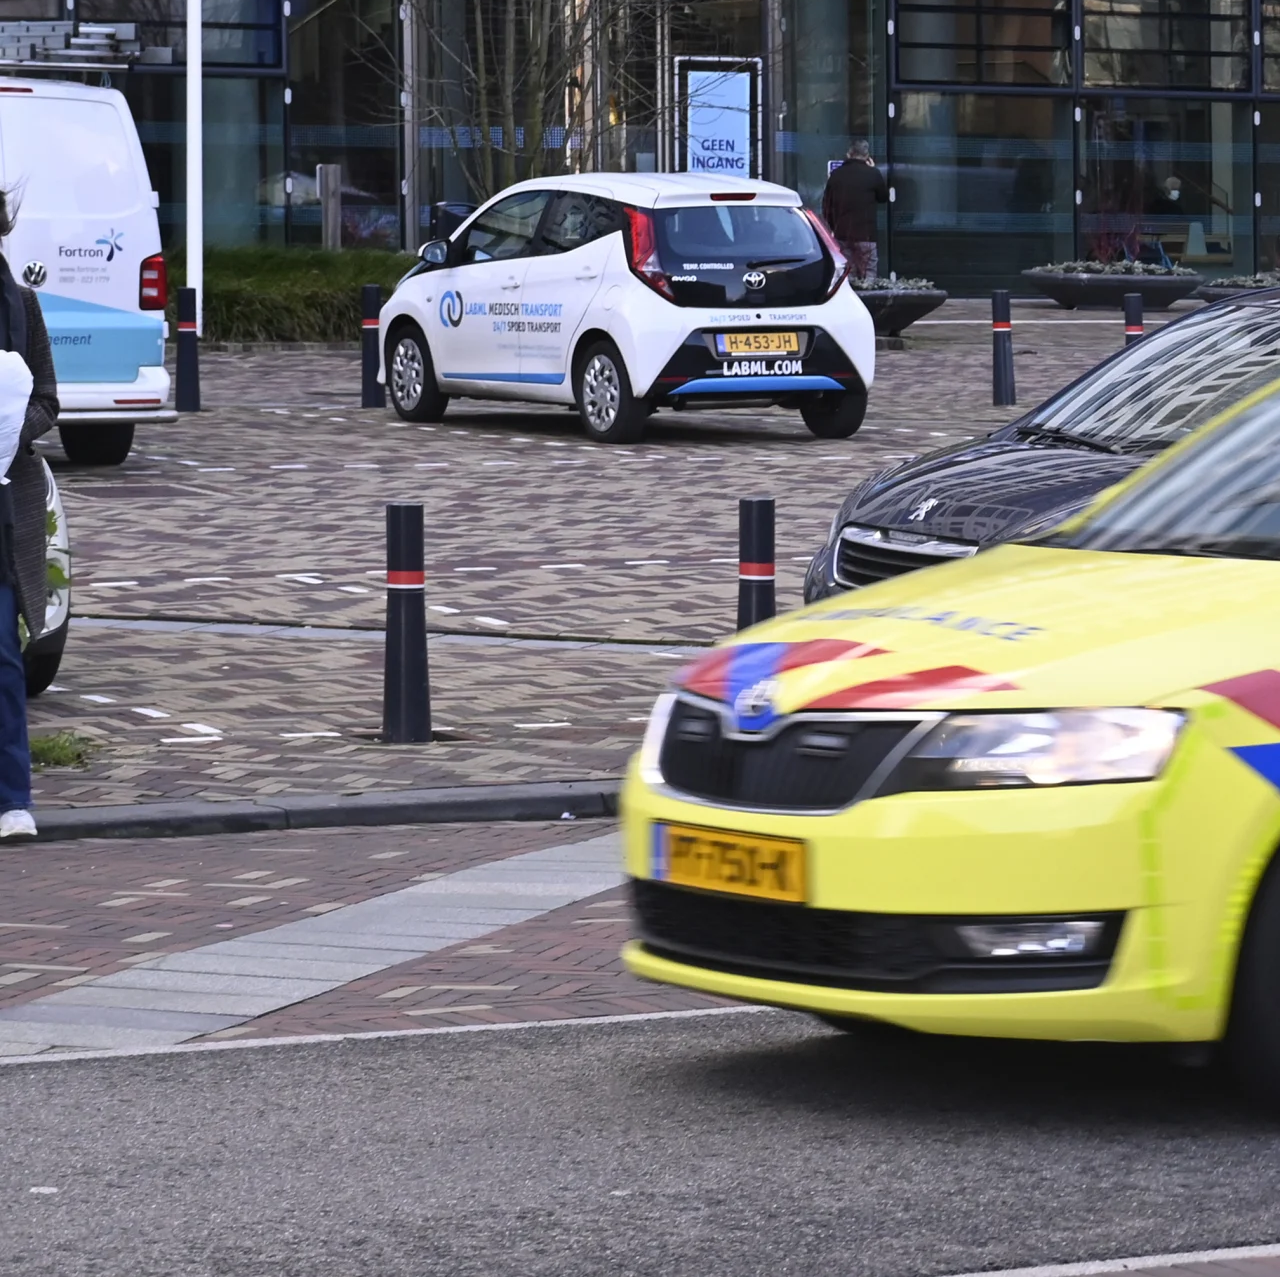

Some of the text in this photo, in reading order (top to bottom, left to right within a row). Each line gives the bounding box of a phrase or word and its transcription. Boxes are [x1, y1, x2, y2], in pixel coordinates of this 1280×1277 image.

[701, 139, 735, 152] GEEN
[692, 156, 745, 170] INGANG
[58, 246, 103, 258] Fortron
[465, 303, 562, 317] LABML MEDISCH TRANSPORT
[728, 314, 751, 322] SPOED
[769, 313, 807, 321] TRANSPORT
[507, 322, 526, 332] SPOED
[527, 322, 561, 333] TRANSPORT
[729, 335, 792, 351] H-453-JH
[722, 360, 803, 376] LABML.COM
